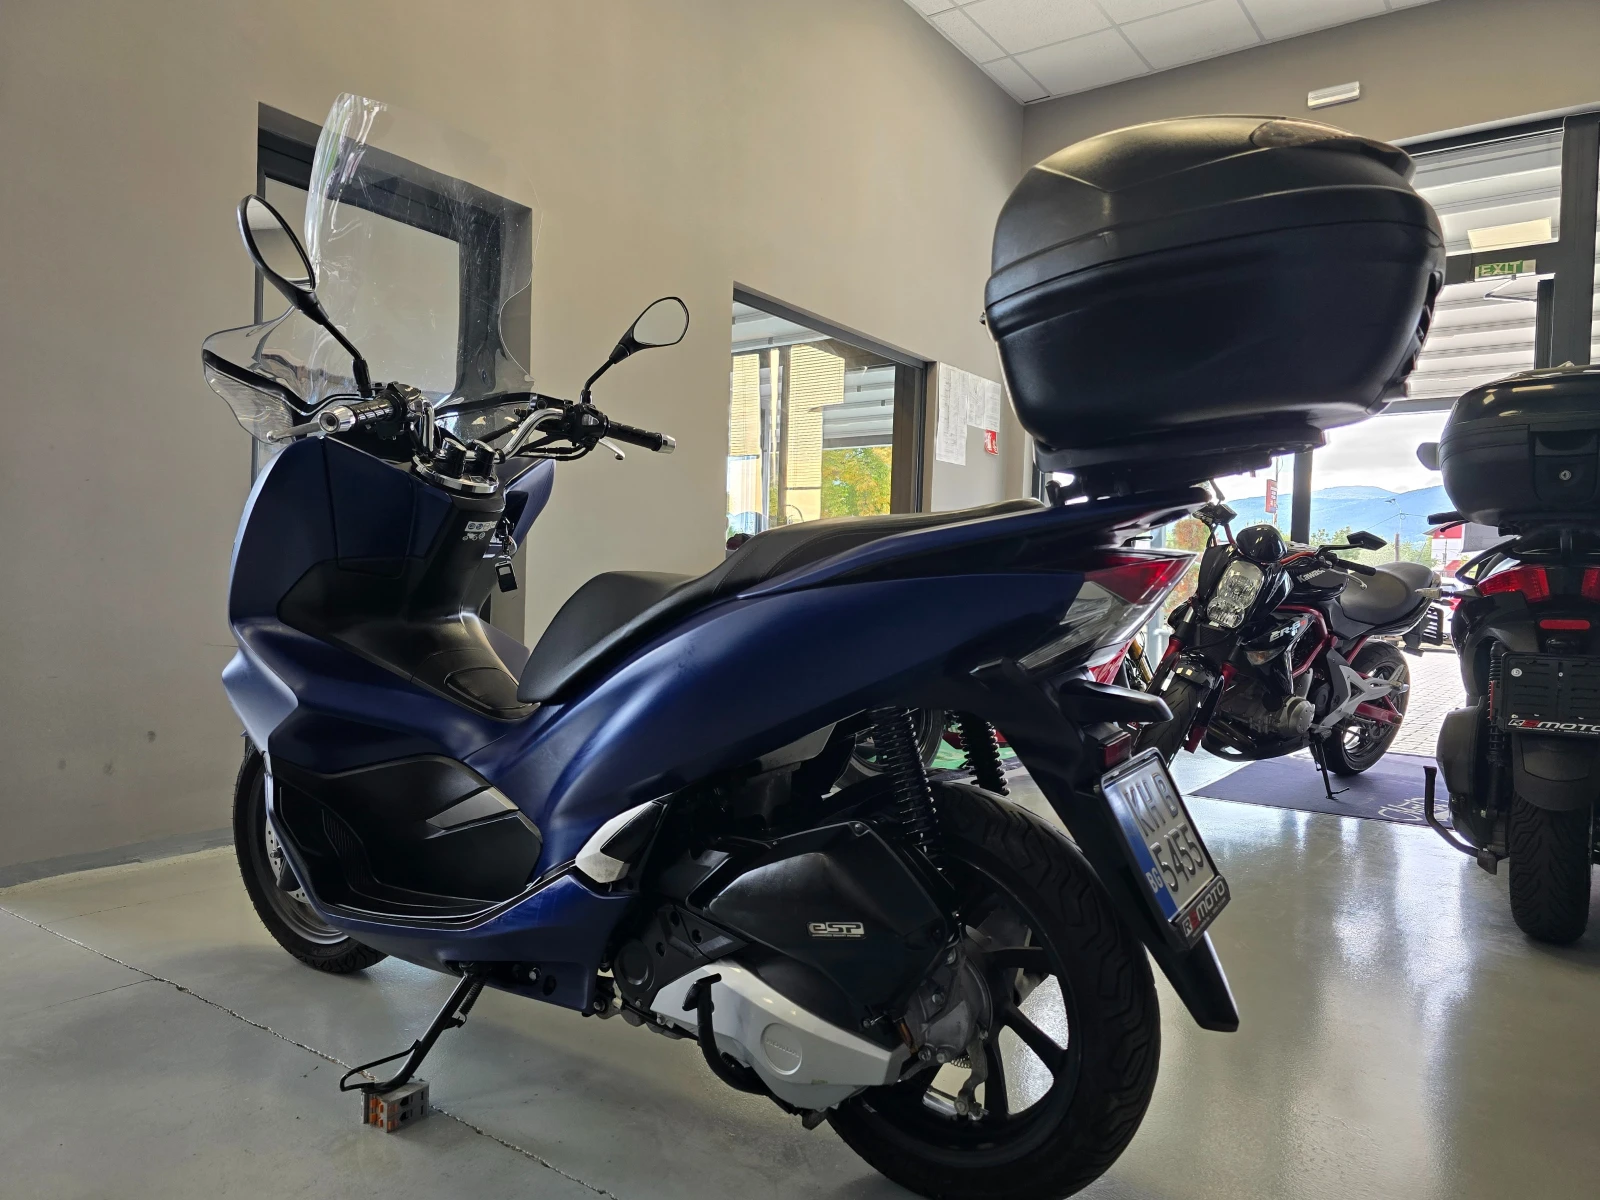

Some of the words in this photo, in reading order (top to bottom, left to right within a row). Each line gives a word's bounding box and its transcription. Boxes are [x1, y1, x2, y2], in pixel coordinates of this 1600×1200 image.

[1481, 261, 1521, 276] EXIT
[1124, 779, 1166, 837] KH
[1152, 772, 1179, 818] B
[1150, 822, 1204, 892] 5455
[1145, 872, 1164, 893] BG
[808, 922, 865, 935] eSP
